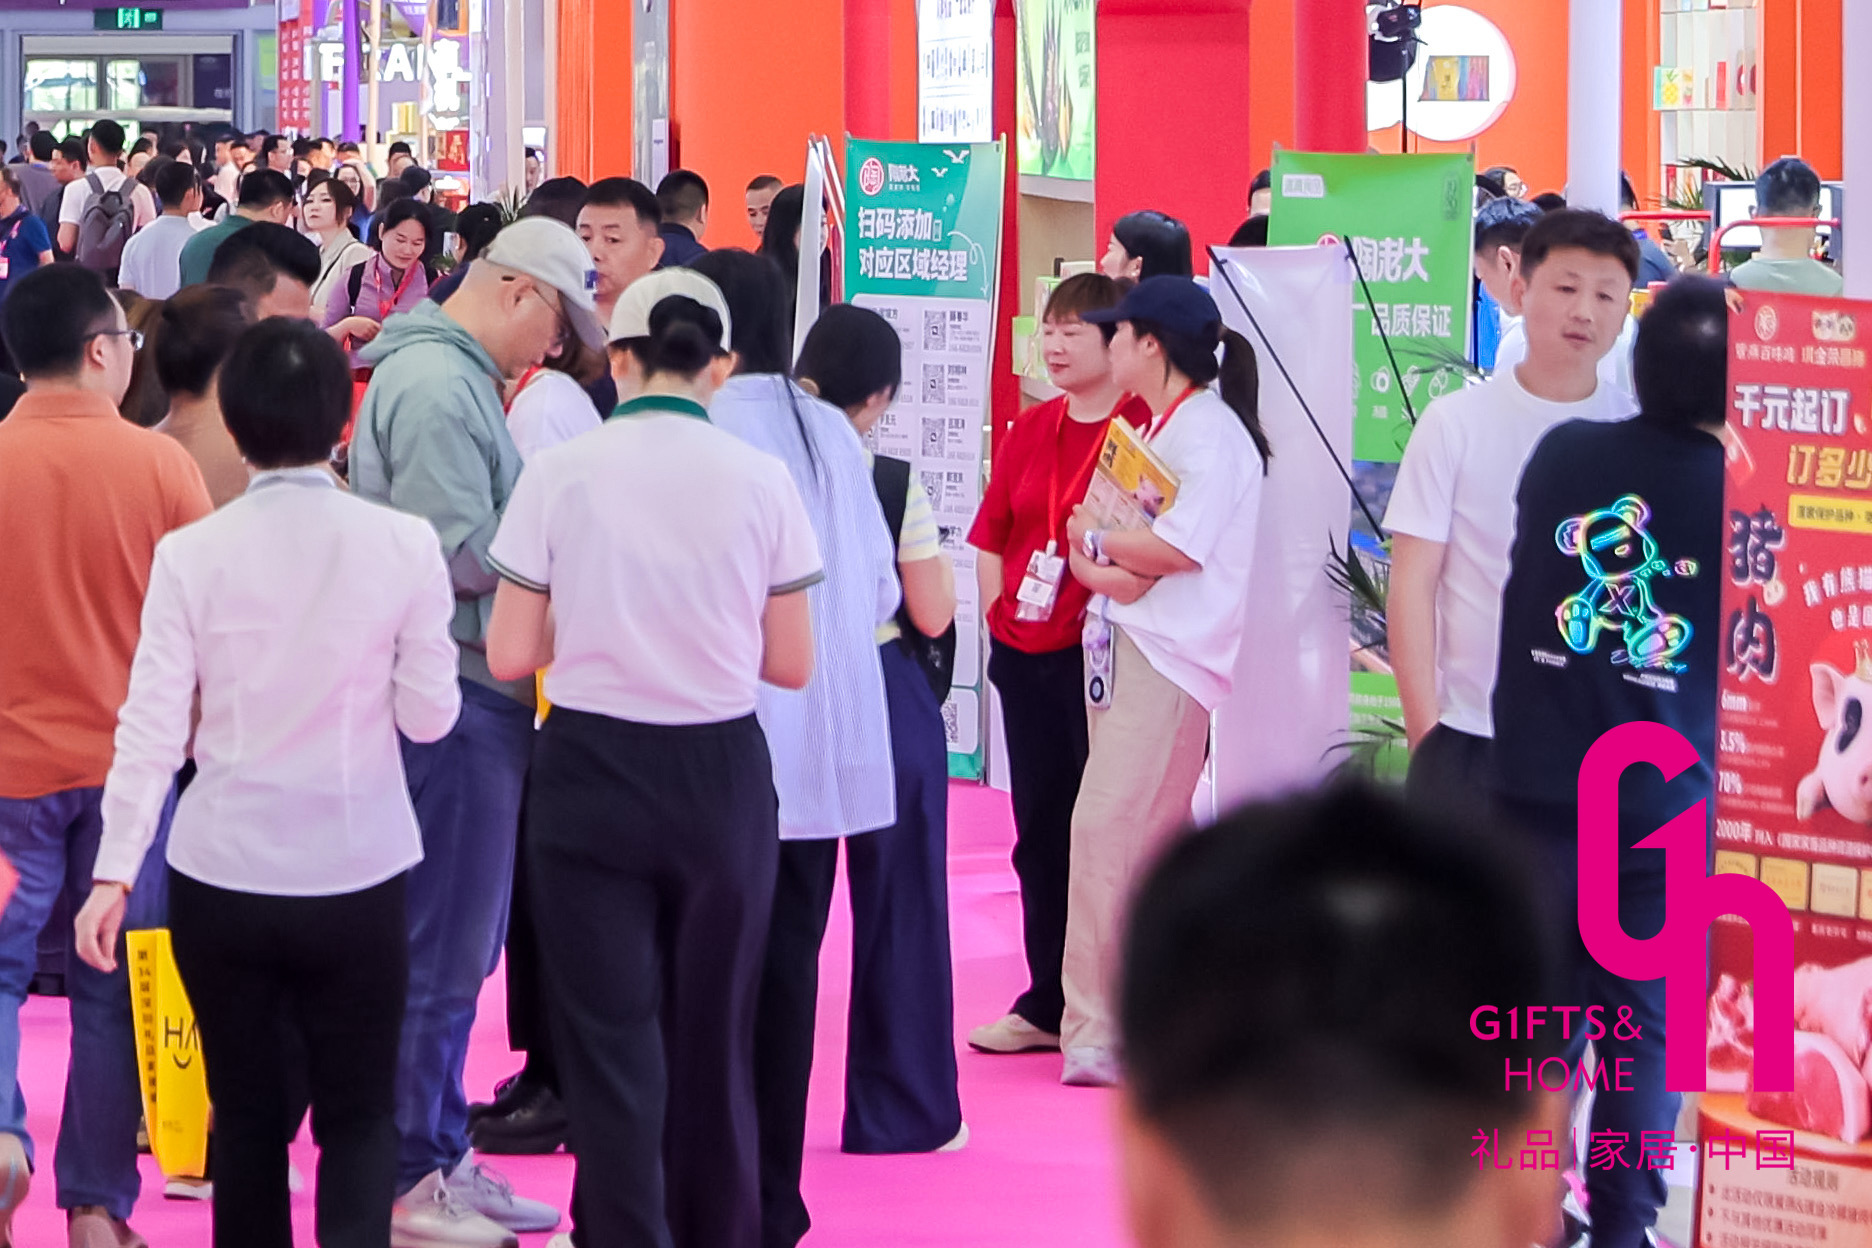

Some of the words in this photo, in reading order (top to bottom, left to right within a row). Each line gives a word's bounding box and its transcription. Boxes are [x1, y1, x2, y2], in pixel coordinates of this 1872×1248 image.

[858, 206, 933, 241] 扫码添加
[859, 246, 968, 282] 对应区域经理
[1371, 303, 1452, 338] 品质保证
[1734, 384, 1850, 436] 千元起订
